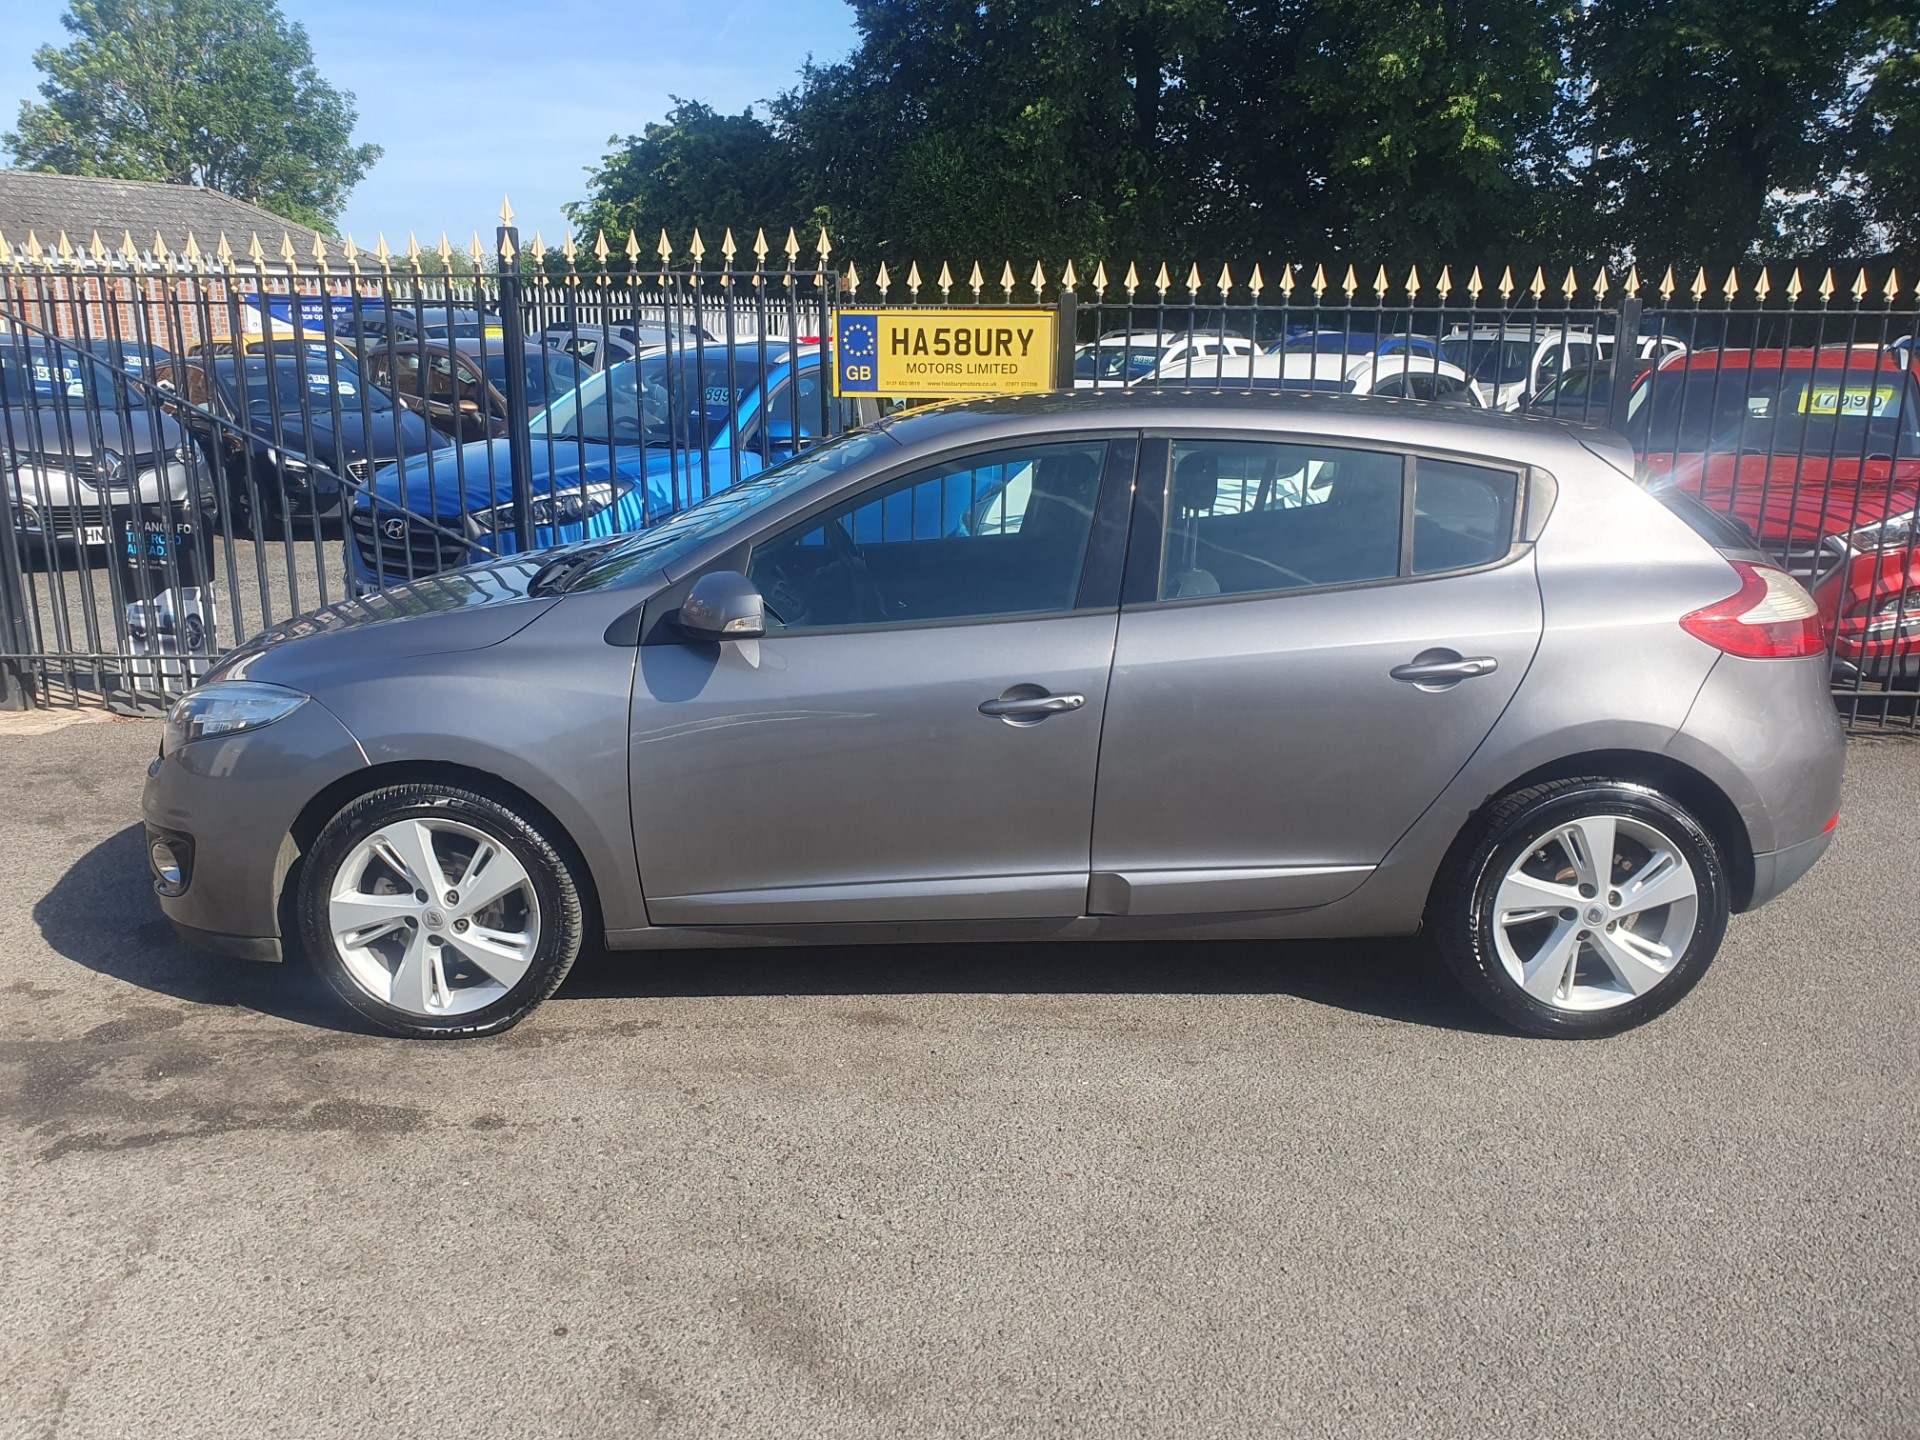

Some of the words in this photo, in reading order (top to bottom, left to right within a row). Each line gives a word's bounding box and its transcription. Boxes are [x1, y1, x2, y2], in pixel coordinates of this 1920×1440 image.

[891, 327, 1034, 357] HA58URY
[846, 365, 871, 381] GB
[906, 362, 963, 375] MOTORS
[967, 363, 1018, 375] LIMITED
